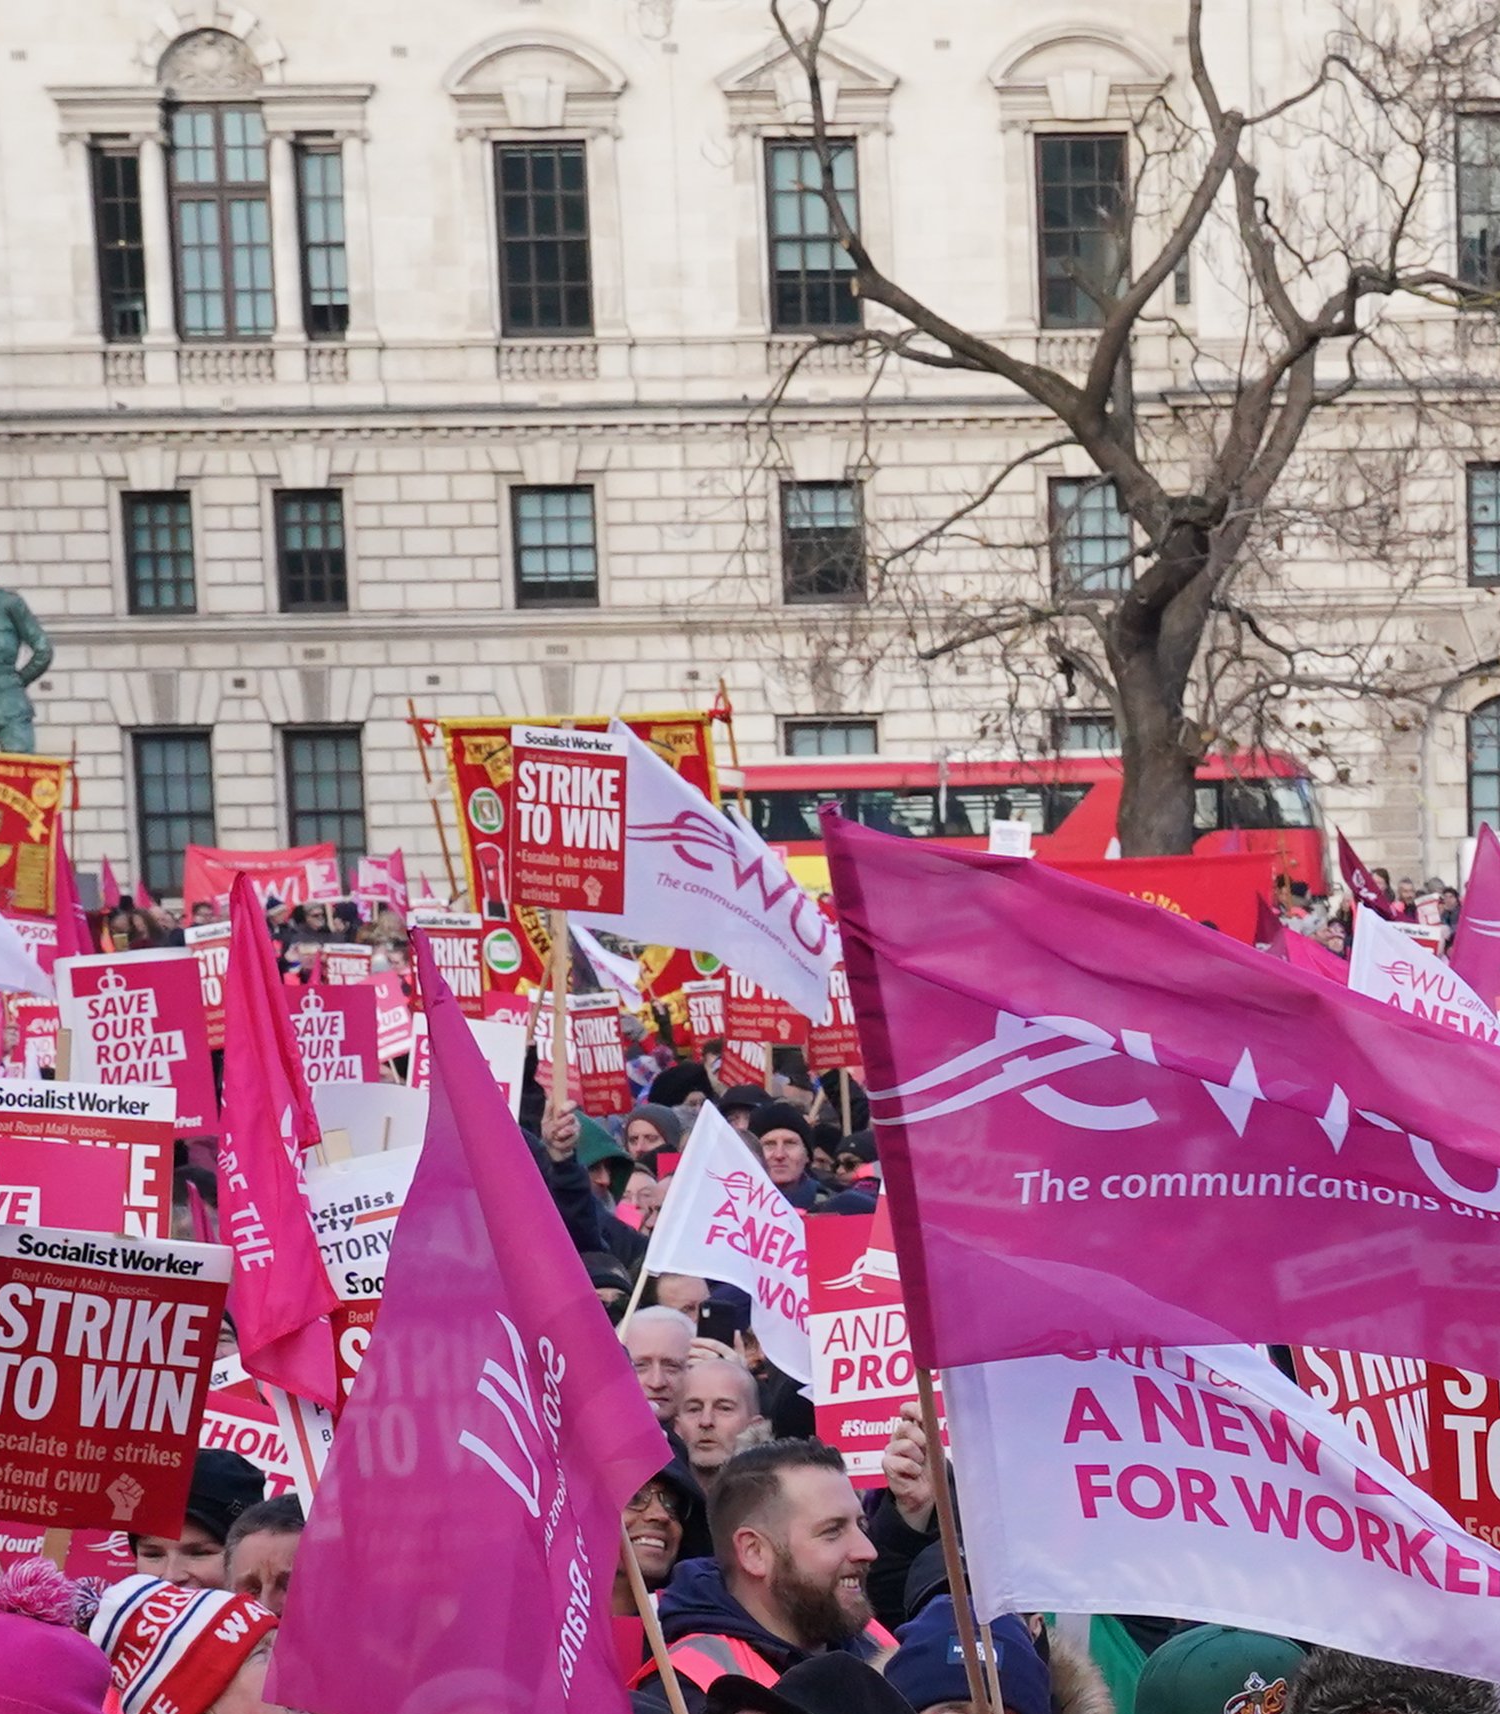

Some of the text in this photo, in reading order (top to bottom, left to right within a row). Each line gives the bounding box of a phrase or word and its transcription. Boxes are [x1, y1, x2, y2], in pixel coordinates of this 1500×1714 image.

[87, 994, 150, 1019] SAVE
[92, 1019, 146, 1042] OUR
[95, 1032, 180, 1064] ROYAL
[99, 1061, 170, 1085] MAIL
[78, 1092, 149, 1116] Worker
[1014, 1168, 1441, 1210] The communications
[16, 1232, 203, 1277] Socialist Worker
[1063, 1386, 1122, 1444] A
[78, 1438, 109, 1463] the
[113, 1442, 182, 1468] strikes
[1074, 1464, 1228, 1525] FOR
